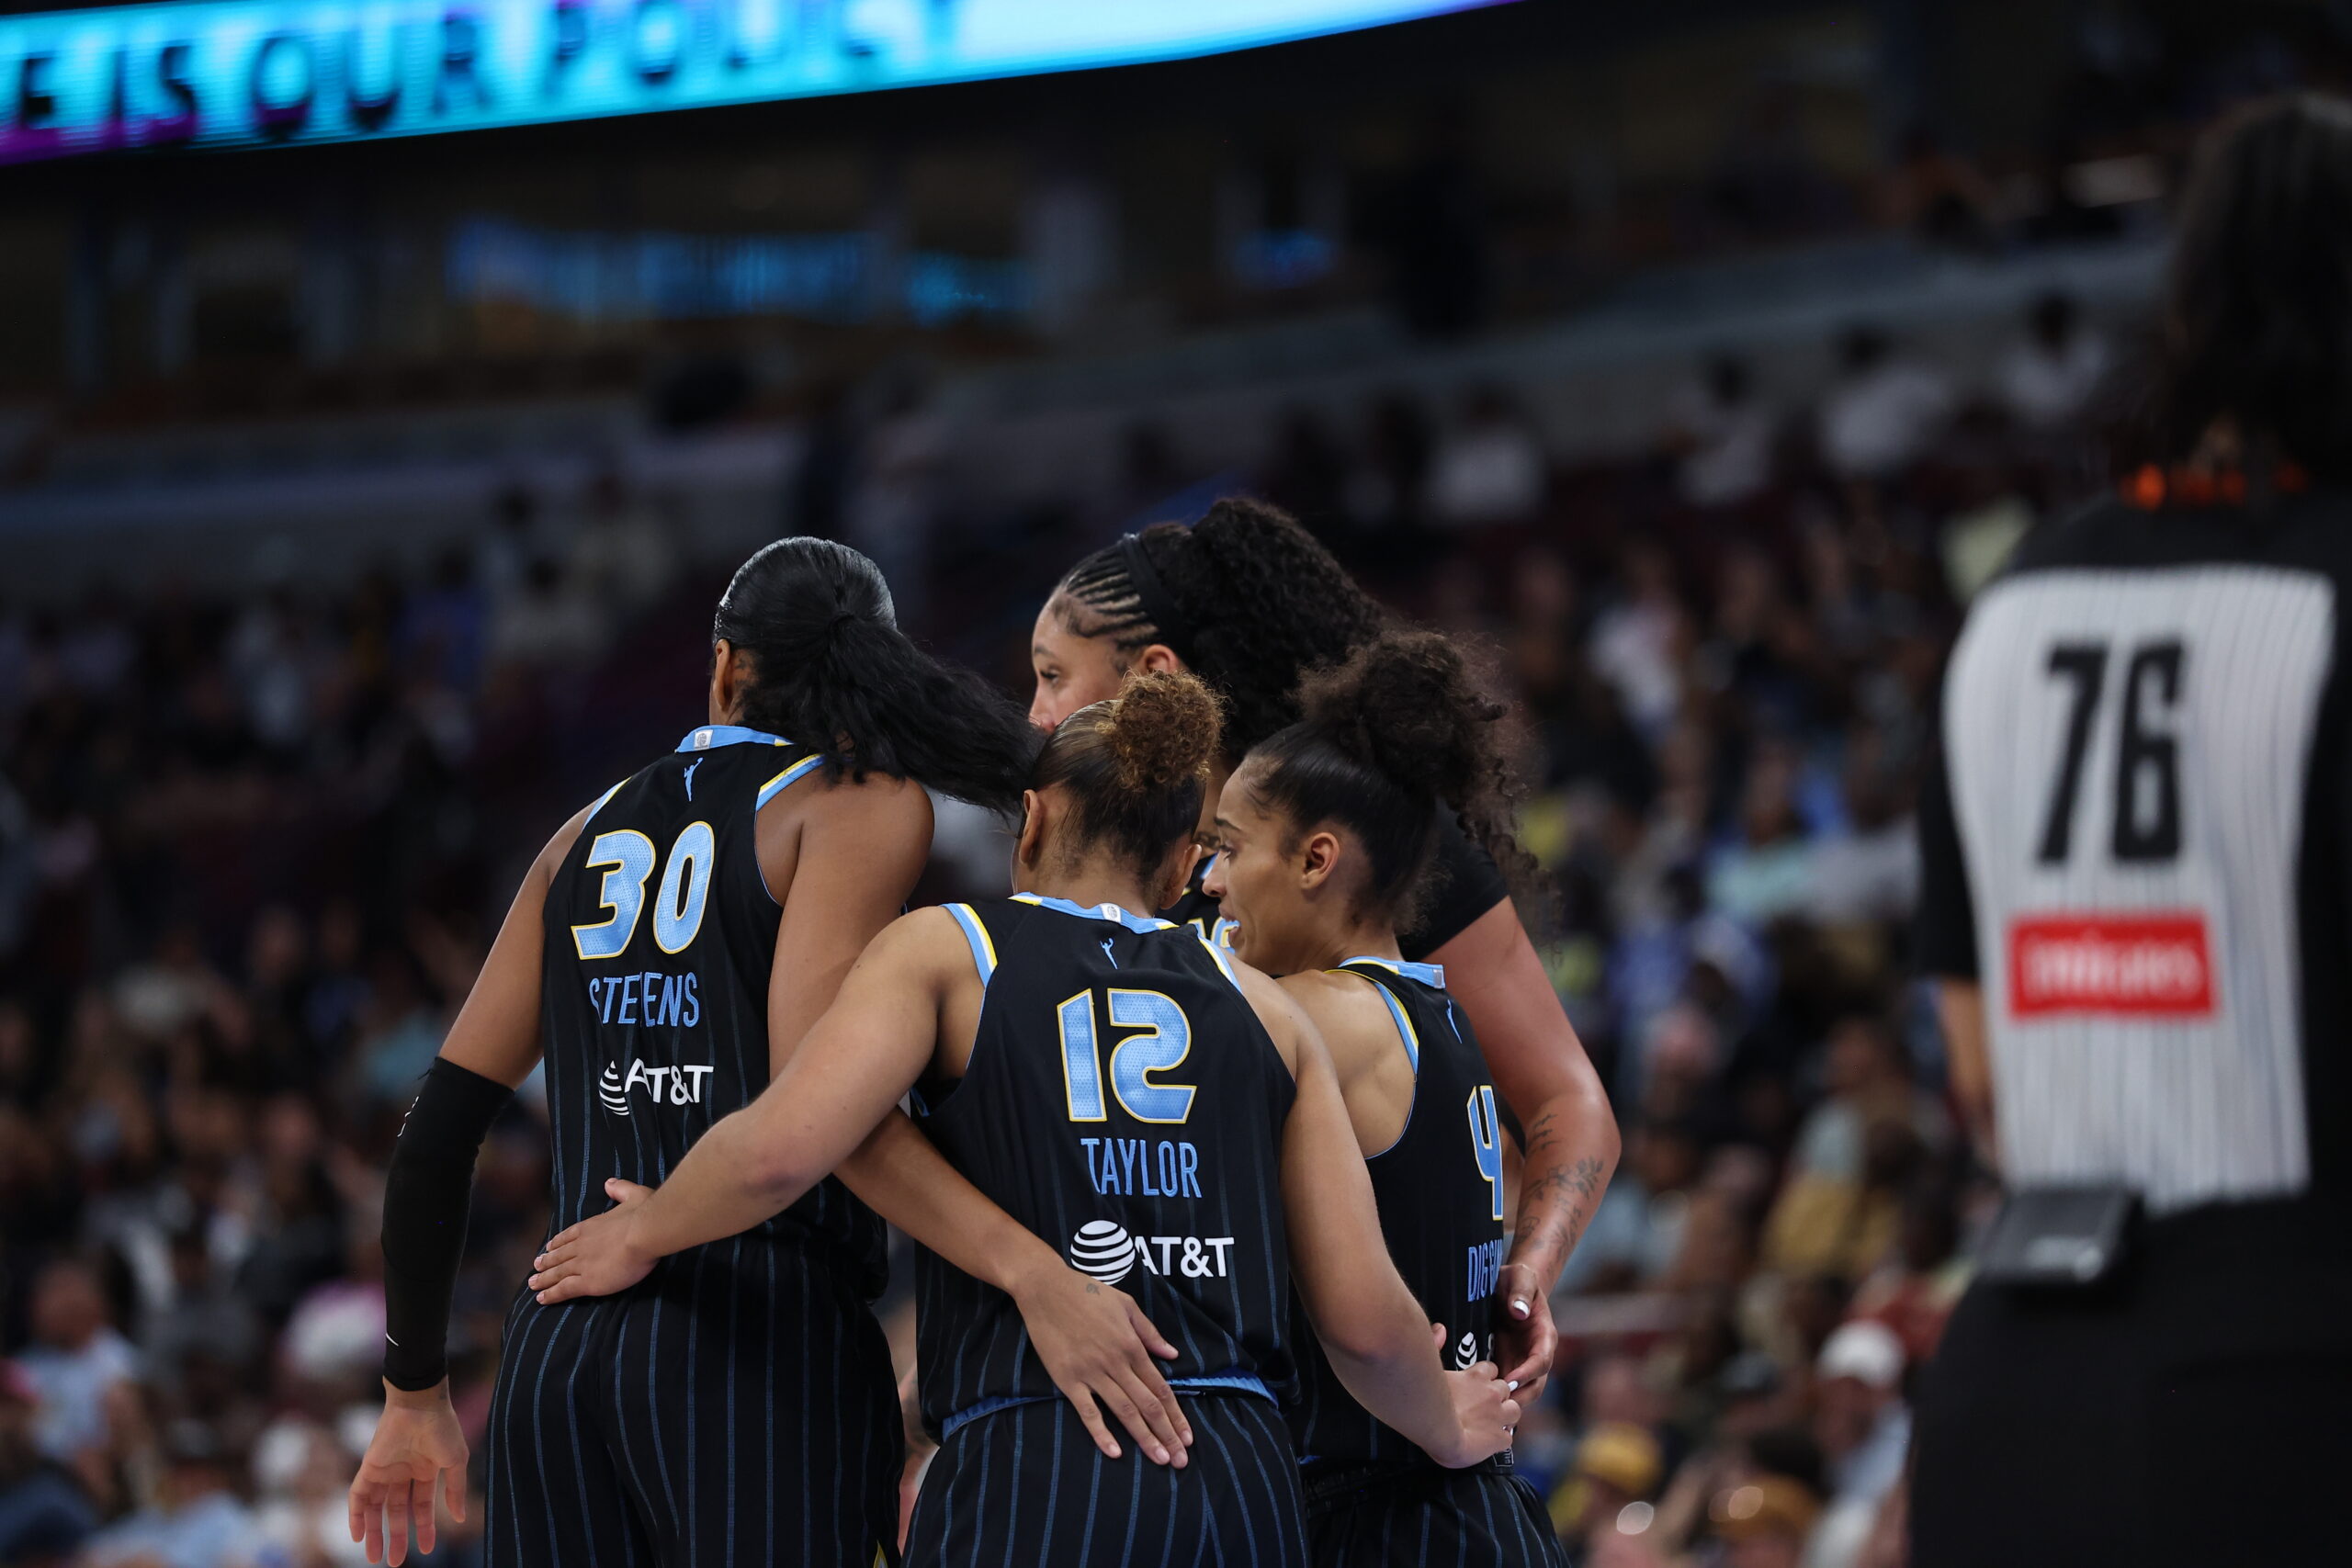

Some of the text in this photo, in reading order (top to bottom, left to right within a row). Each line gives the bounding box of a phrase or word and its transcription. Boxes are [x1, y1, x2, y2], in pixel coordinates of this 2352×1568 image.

[105, 42, 197, 145] IS
[246, 11, 496, 143] OUR
[2035, 641, 2183, 867] 76
[571, 820, 715, 960] 30
[624, 1058, 714, 1105] AT&T
[1057, 987, 1197, 1124] 12
[1080, 1137, 1203, 1198] TAYLOR
[1466, 1085, 1504, 1221] 4
[1134, 1235, 1235, 1279] AT&T
